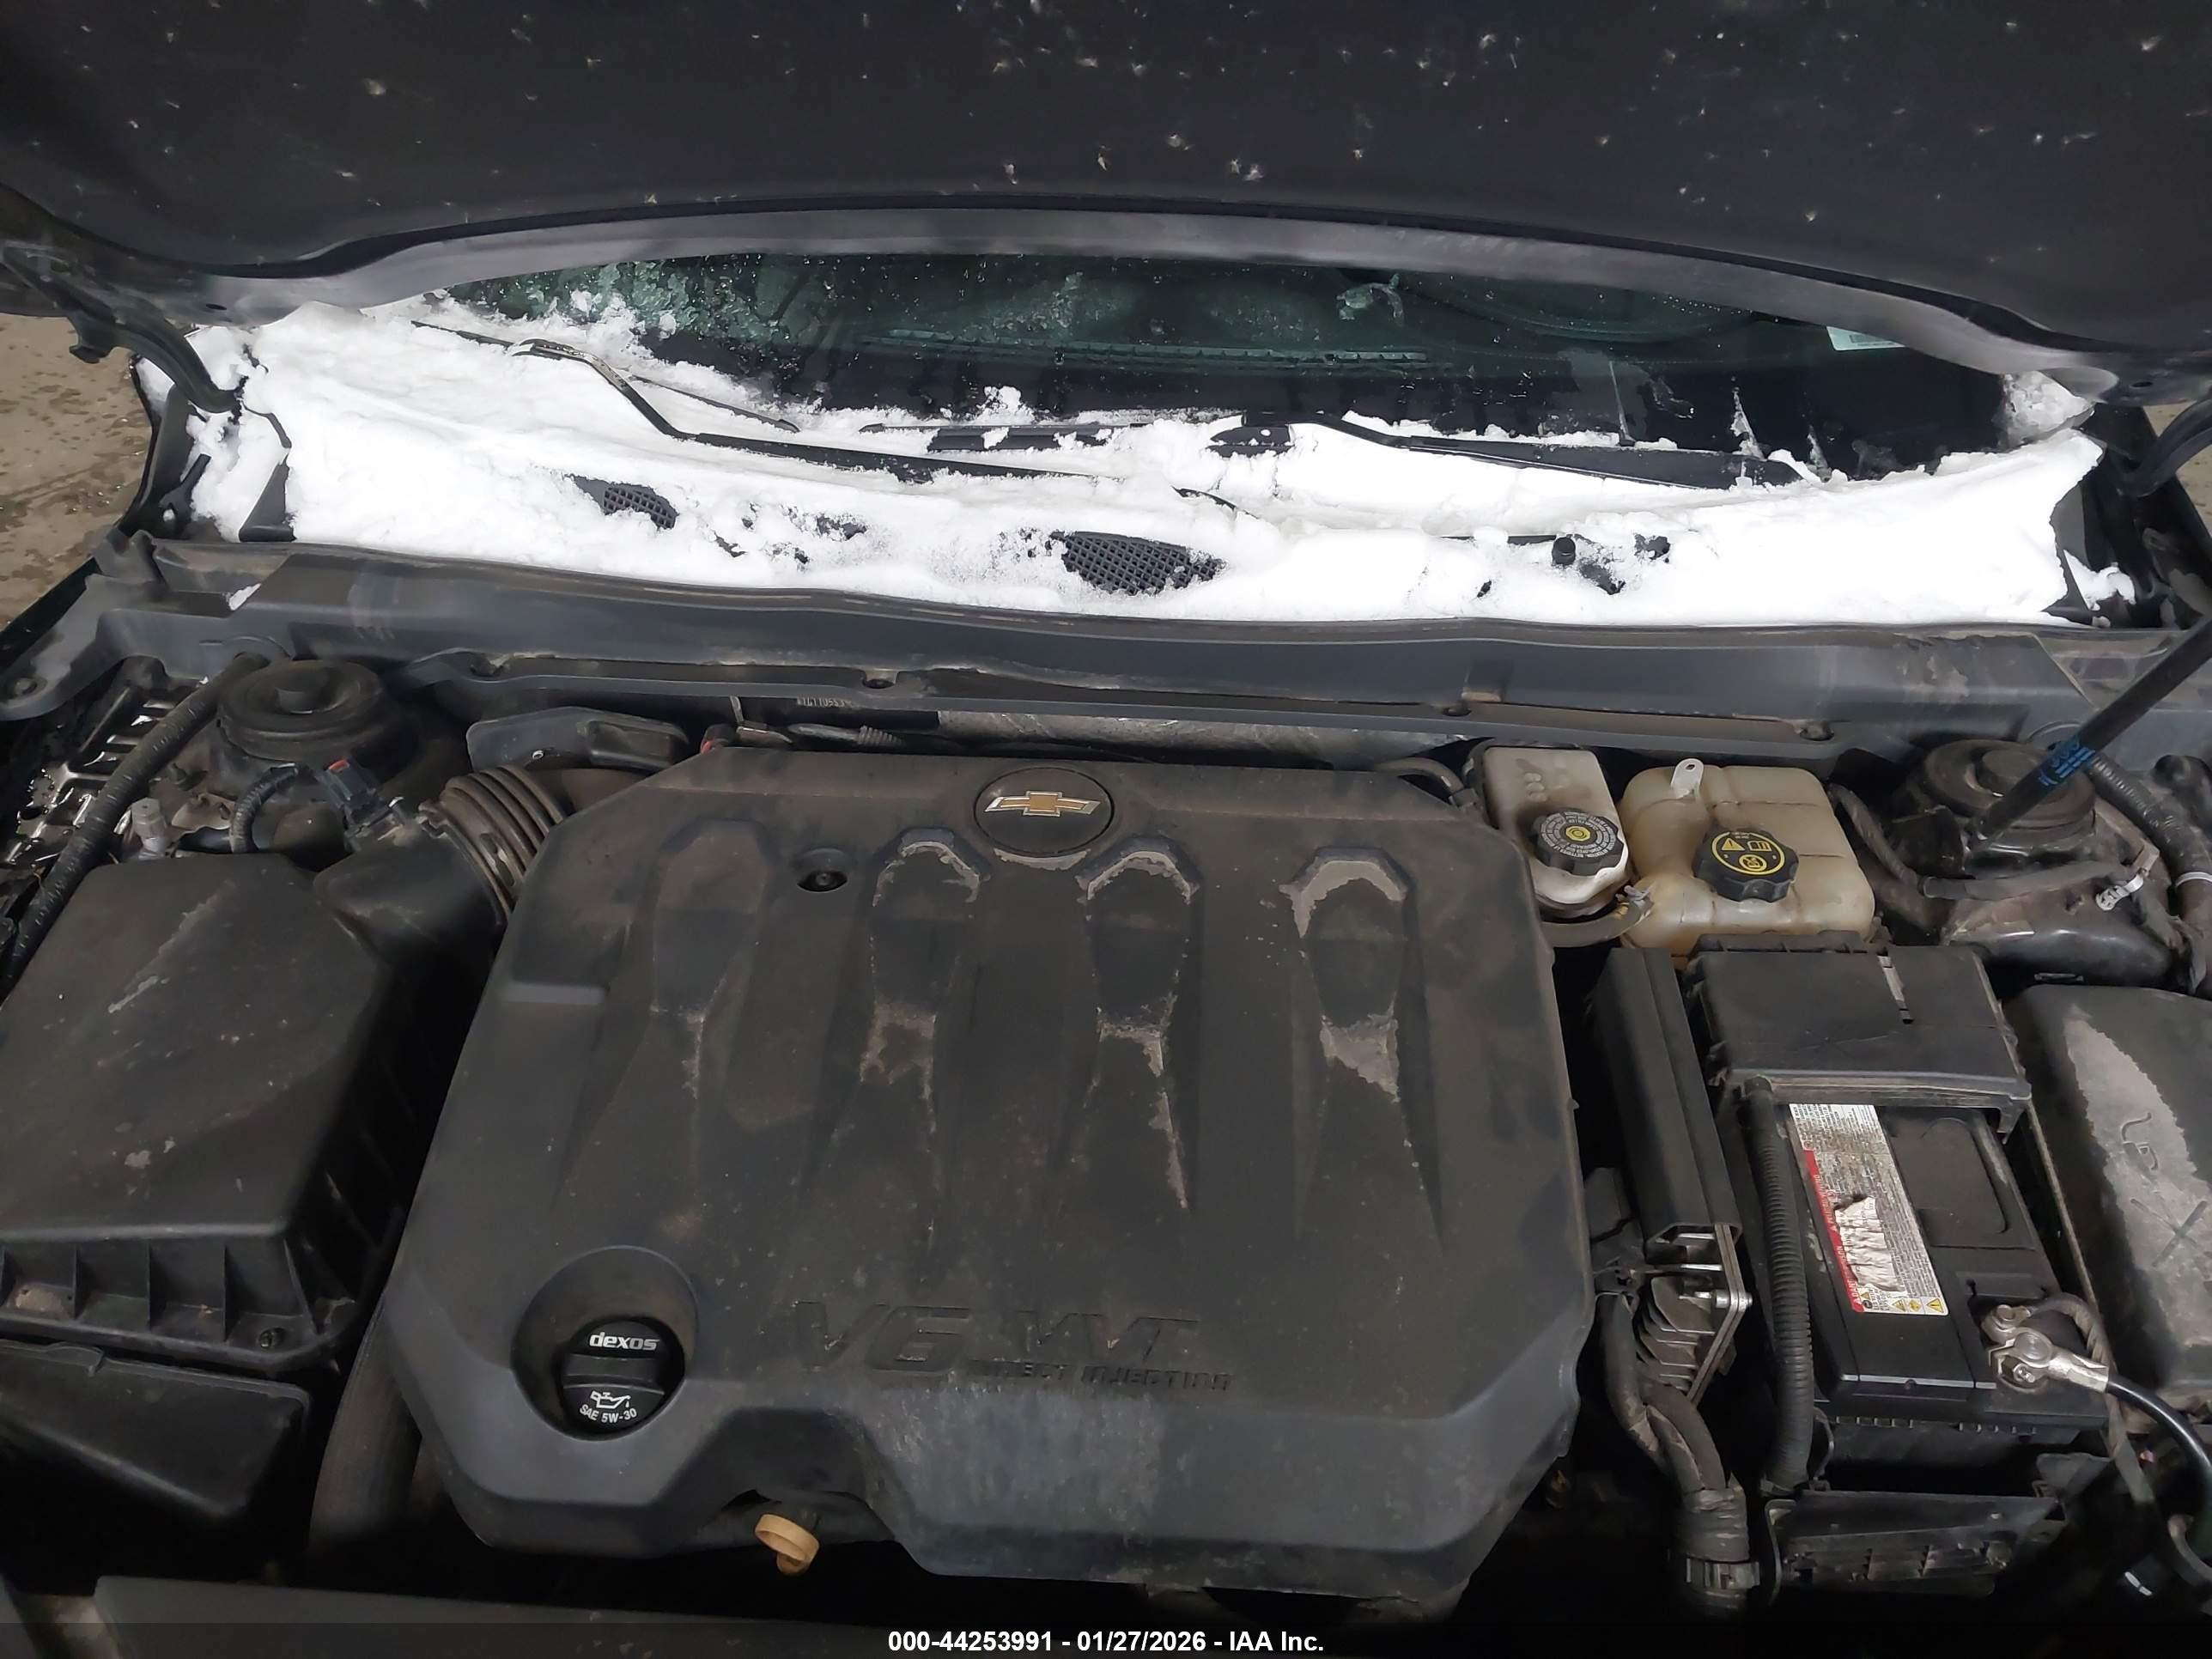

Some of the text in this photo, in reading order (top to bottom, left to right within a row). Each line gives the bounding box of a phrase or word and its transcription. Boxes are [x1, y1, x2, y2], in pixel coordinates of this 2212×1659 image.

[589, 1332, 660, 1351] dexos
[793, 1301, 969, 1372] V6
[580, 1404, 637, 1423] SAE 5W-30
